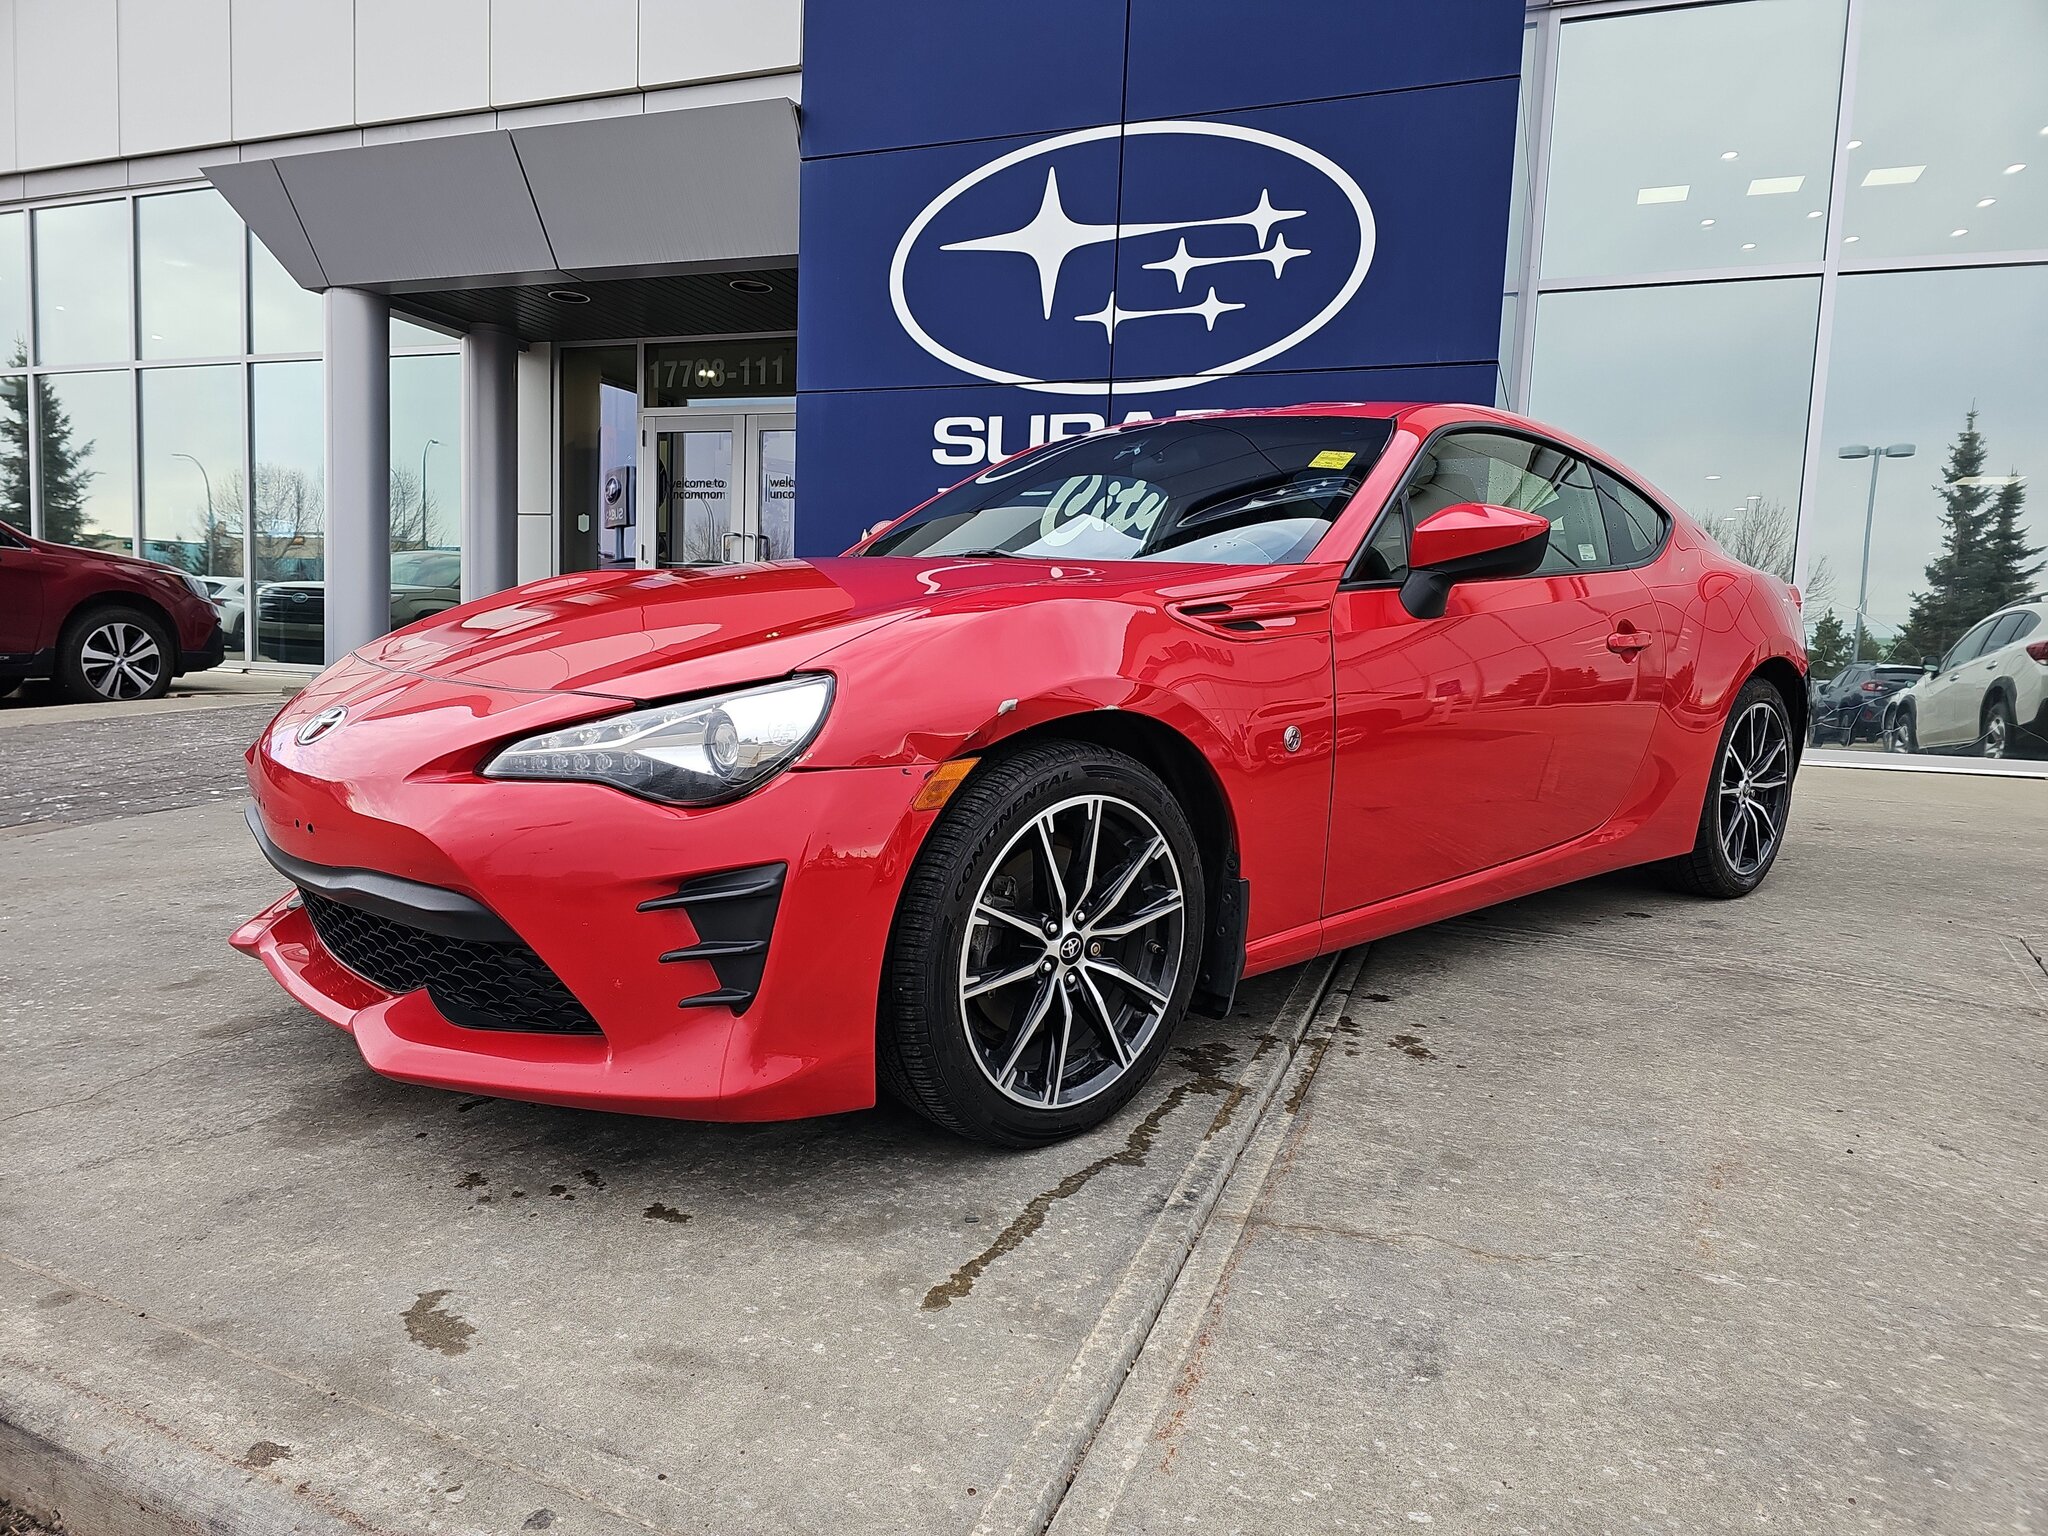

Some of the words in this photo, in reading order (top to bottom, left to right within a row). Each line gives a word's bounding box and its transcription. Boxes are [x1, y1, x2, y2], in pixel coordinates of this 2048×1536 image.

[713, 478, 725, 488] to
[769, 475, 795, 488] welc
[1040, 474, 1169, 551] City
[954, 769, 1073, 902] CONTINENTAL
